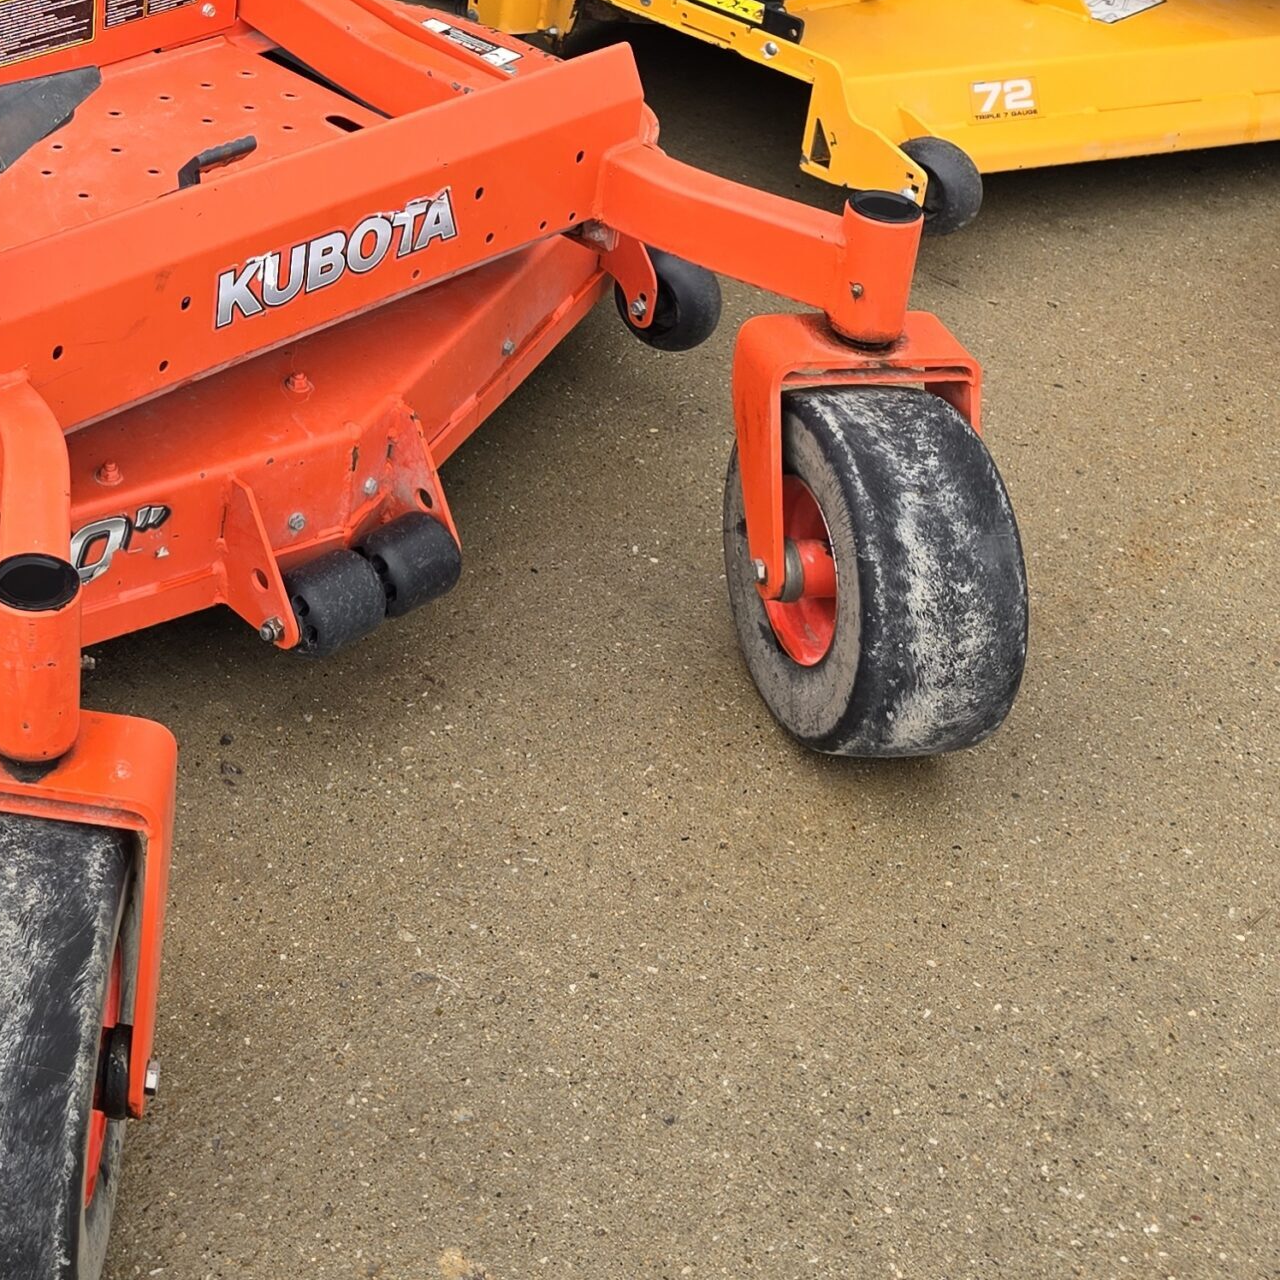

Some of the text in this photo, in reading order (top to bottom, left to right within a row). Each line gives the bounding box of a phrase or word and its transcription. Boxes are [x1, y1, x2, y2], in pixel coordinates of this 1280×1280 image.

[973, 79, 1035, 112] 72
[974, 112, 1001, 121] TRIPLE
[1011, 108, 1038, 117] GAUGE
[214, 186, 458, 329] KUBOTA
[70, 503, 171, 585] 0"
